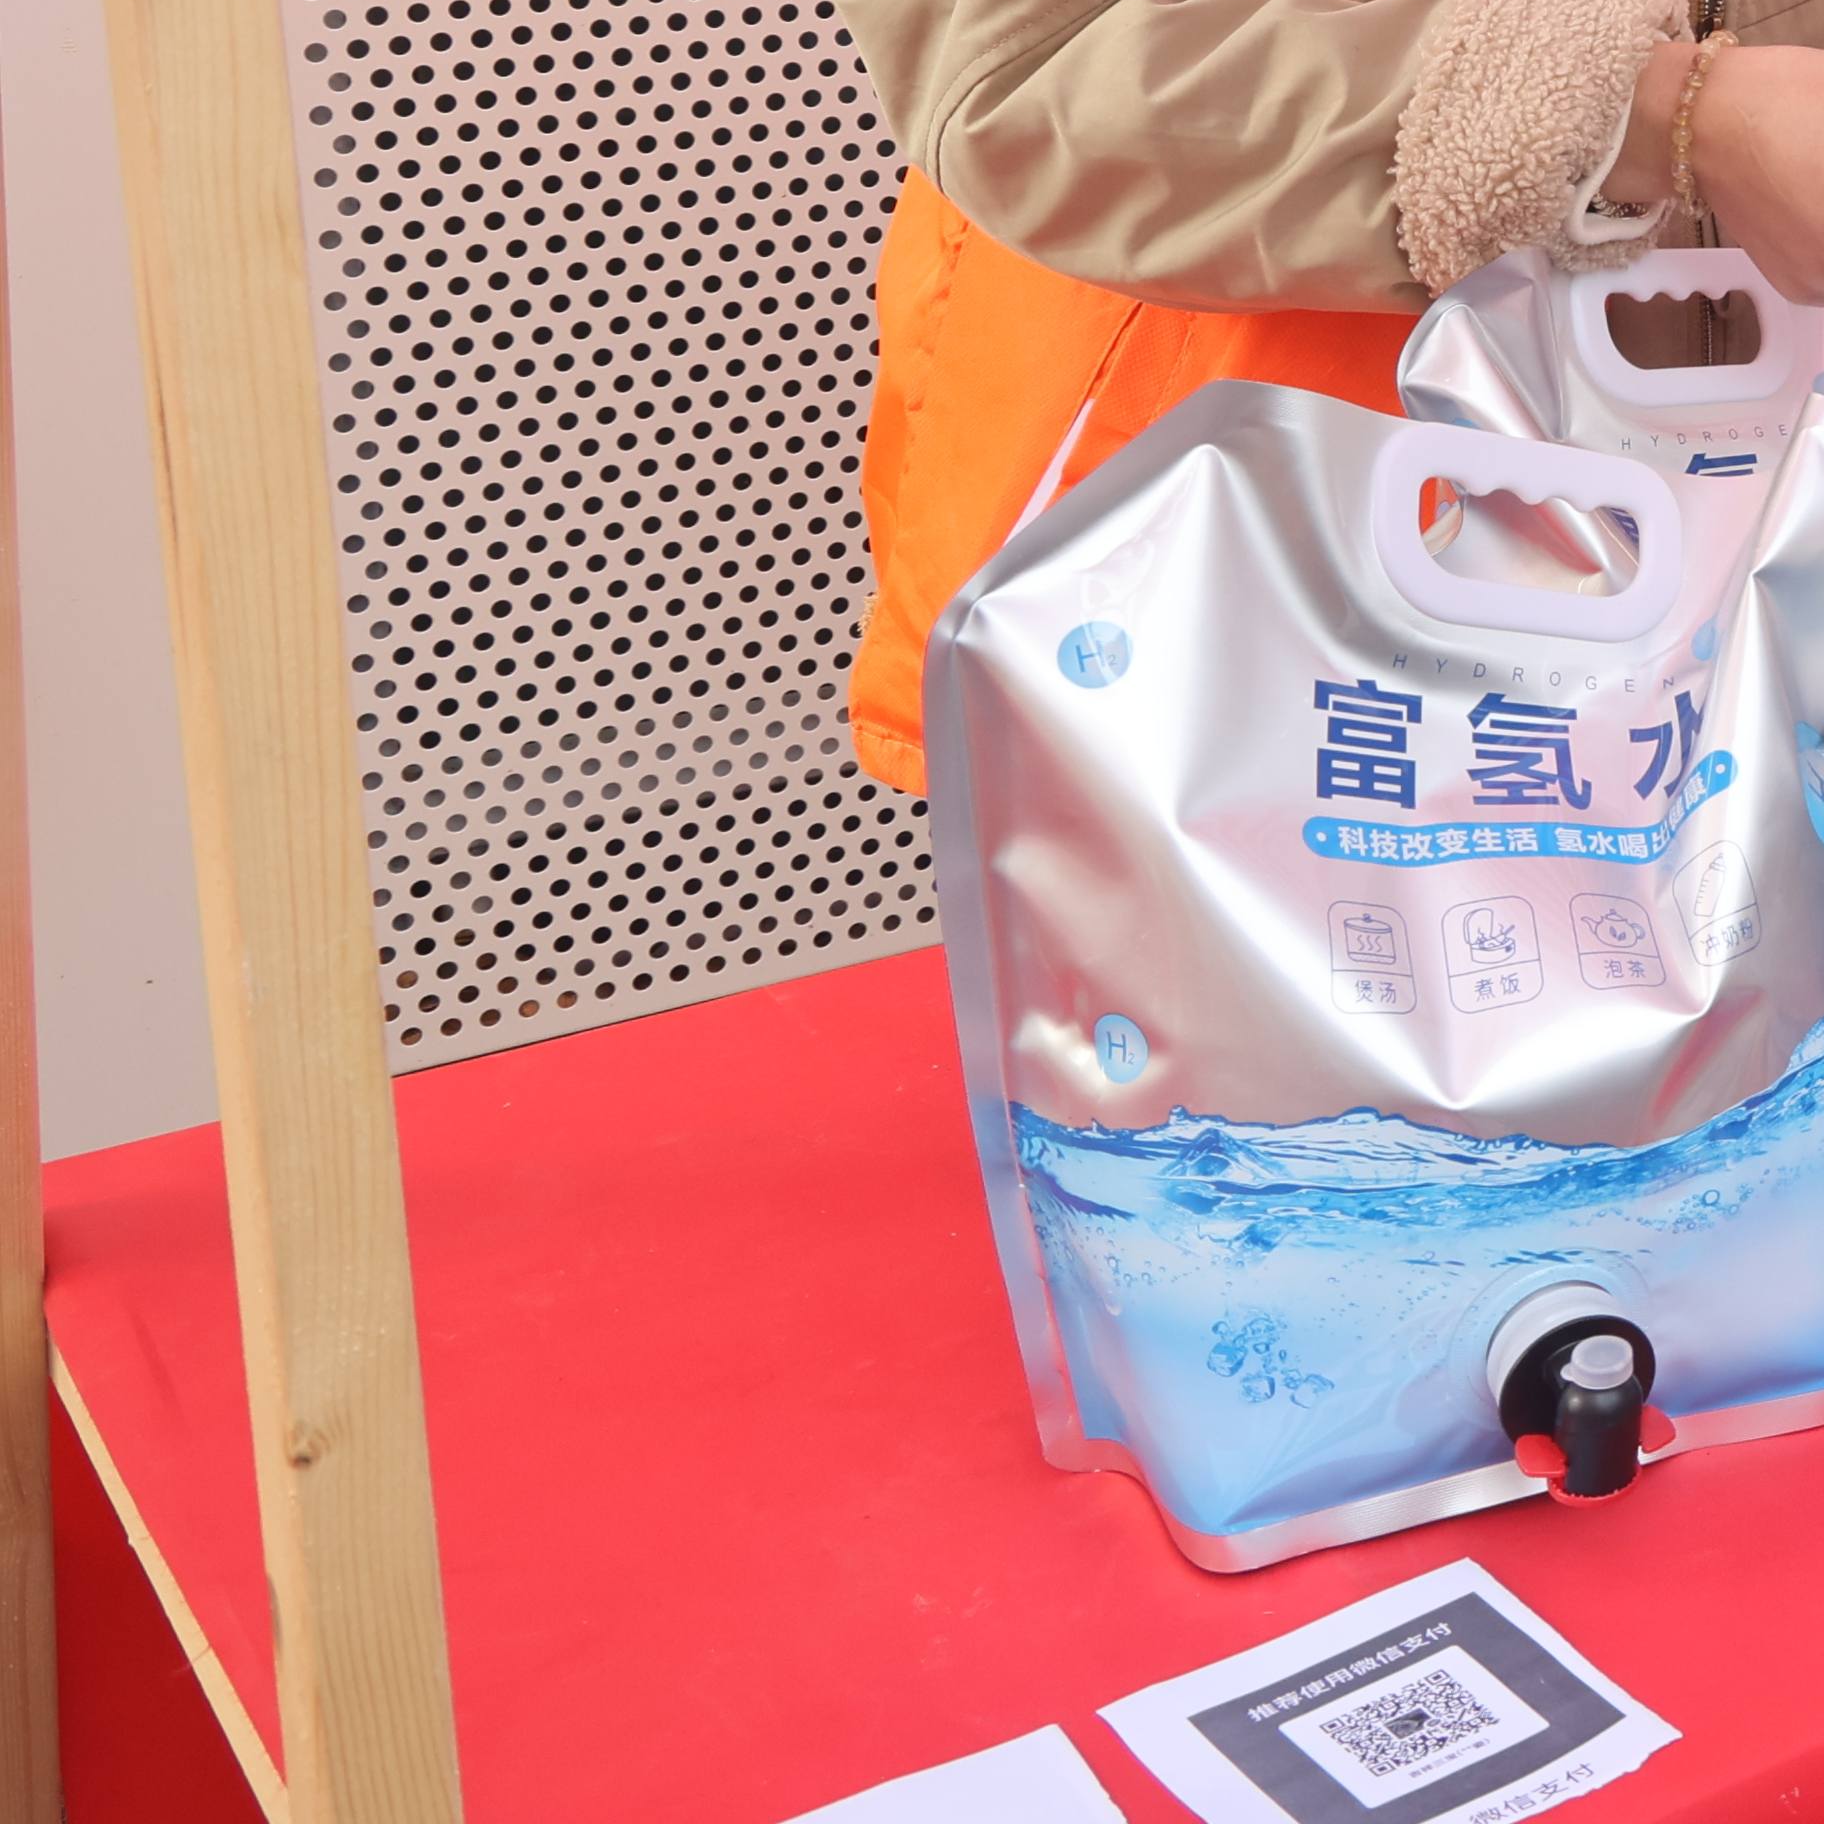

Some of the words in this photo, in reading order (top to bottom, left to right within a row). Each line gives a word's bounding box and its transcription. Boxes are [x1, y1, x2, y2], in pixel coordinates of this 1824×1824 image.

[1393, 654, 1675, 694] HYDROGEN
[1338, 826, 1539, 861] 科技改变生活
[1700, 921, 1756, 959] 冲奶粉
[1474, 973, 1523, 1001] 煮饭
[1603, 960, 1647, 980] 泡茶
[1354, 979, 1398, 1004] 煲汤
[1247, 1621, 1453, 1723] 推荐使用微信支付
